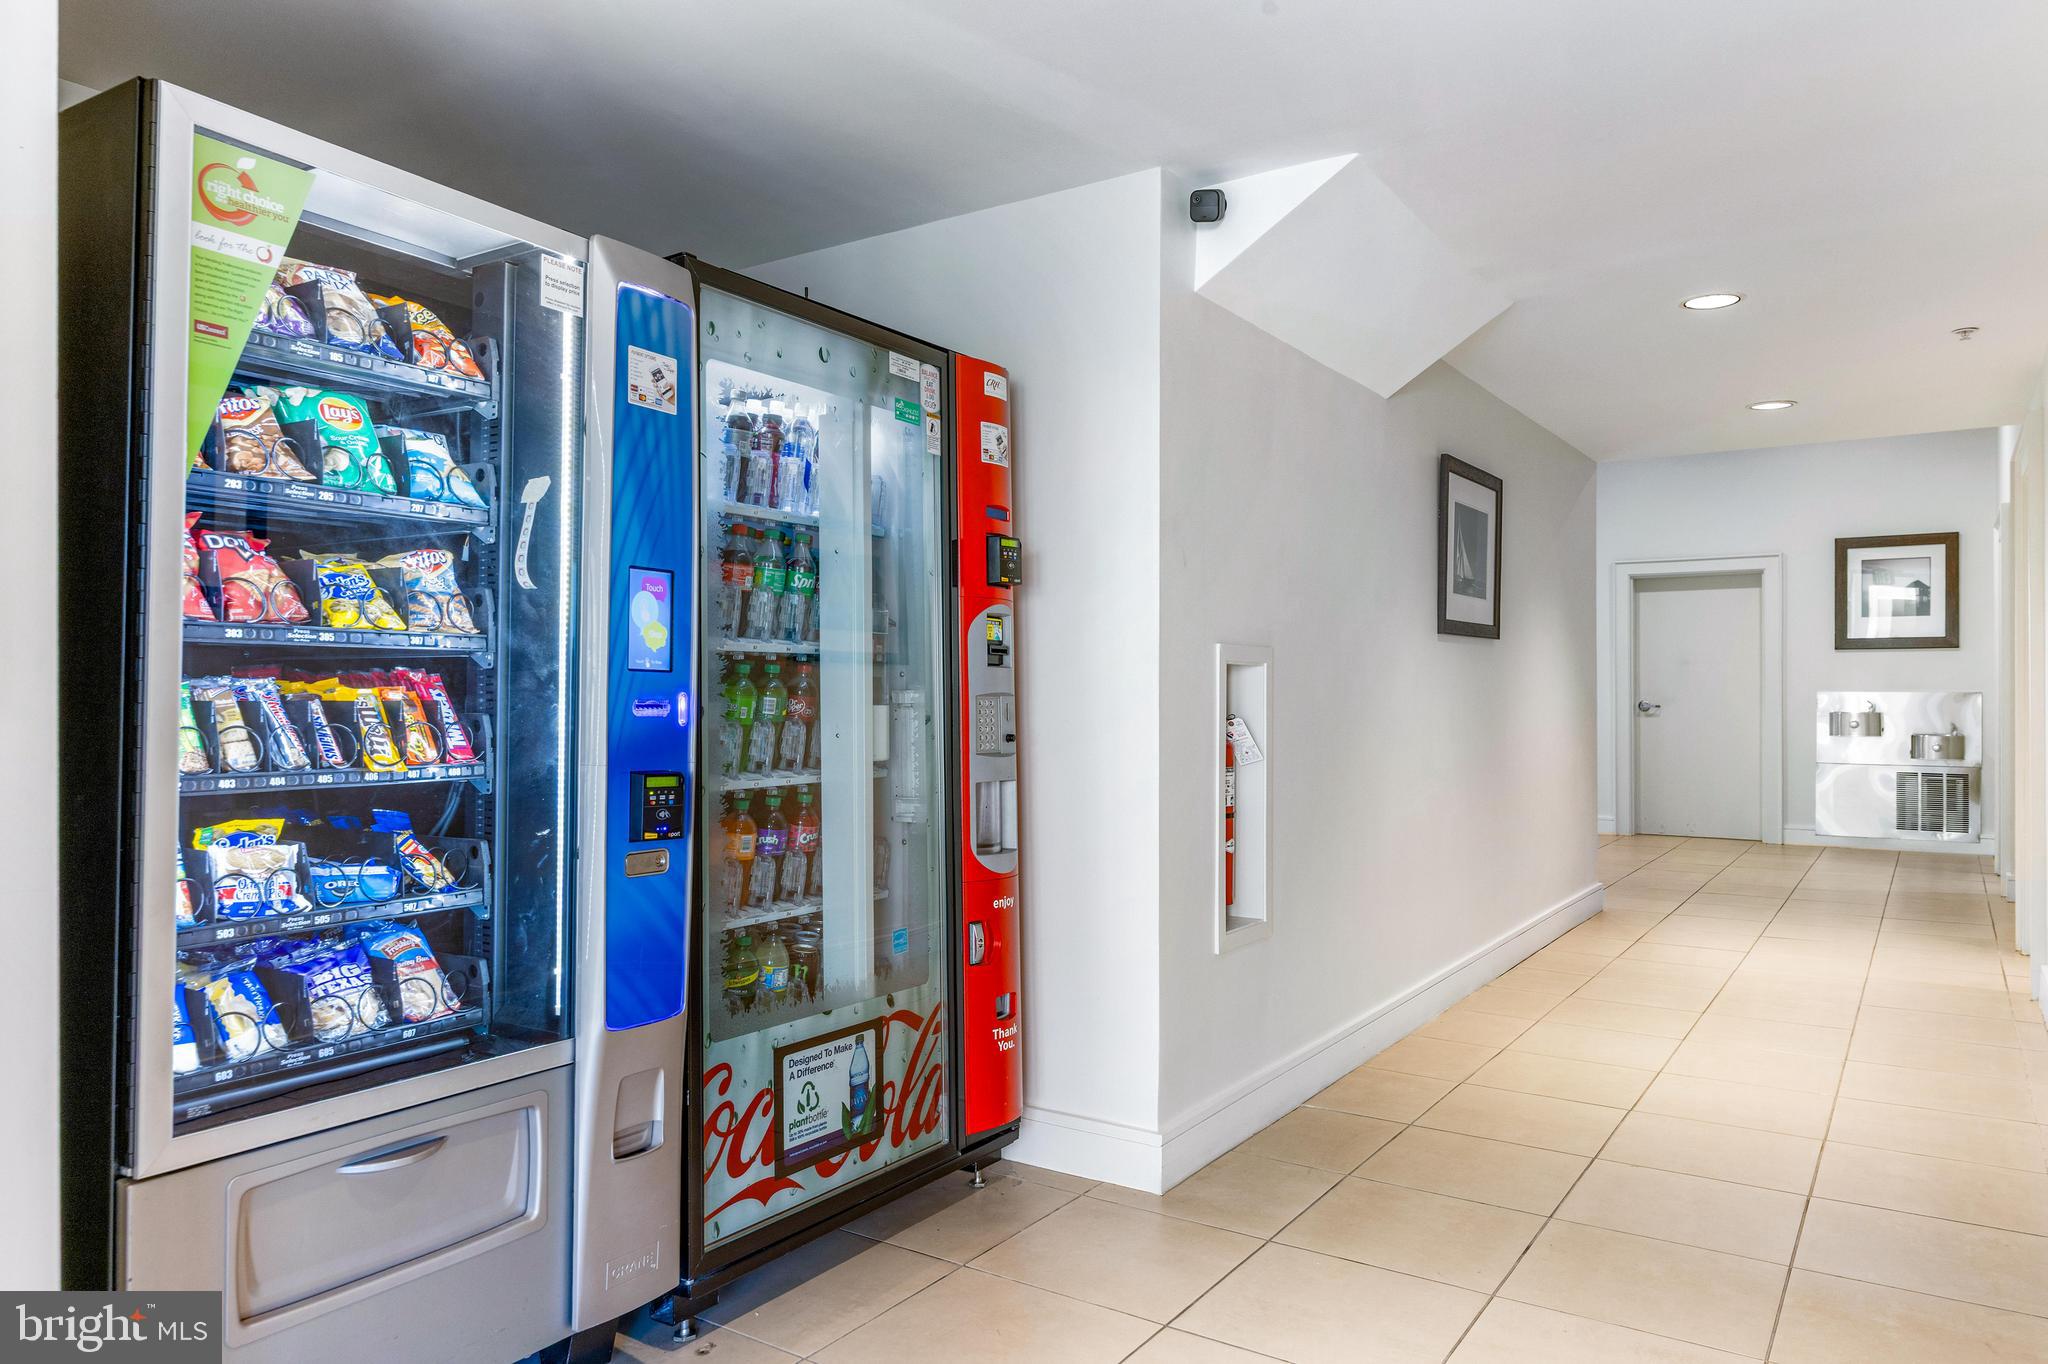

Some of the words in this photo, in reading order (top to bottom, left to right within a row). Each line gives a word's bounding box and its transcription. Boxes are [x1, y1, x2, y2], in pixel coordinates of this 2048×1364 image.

[206, 180, 242, 203] right
[243, 191, 284, 213] choice
[272, 211, 289, 223] you
[645, 583, 664, 592] Touch
[269, 777, 286, 786] 404
[993, 896, 1014, 909] enjoy
[281, 920, 311, 929] Selection
[312, 963, 361, 984] BIG
[310, 974, 373, 998] TEXAS
[992, 1024, 1018, 1040] Thank
[280, 1055, 311, 1066] Selection
[789, 1051, 823, 1069] Designed
[824, 1048, 833, 1057] To
[834, 1042, 853, 1054] Make
[789, 1071, 796, 1081] A
[797, 1061, 835, 1079] Difference
[789, 1109, 828, 1133] plantbottle
